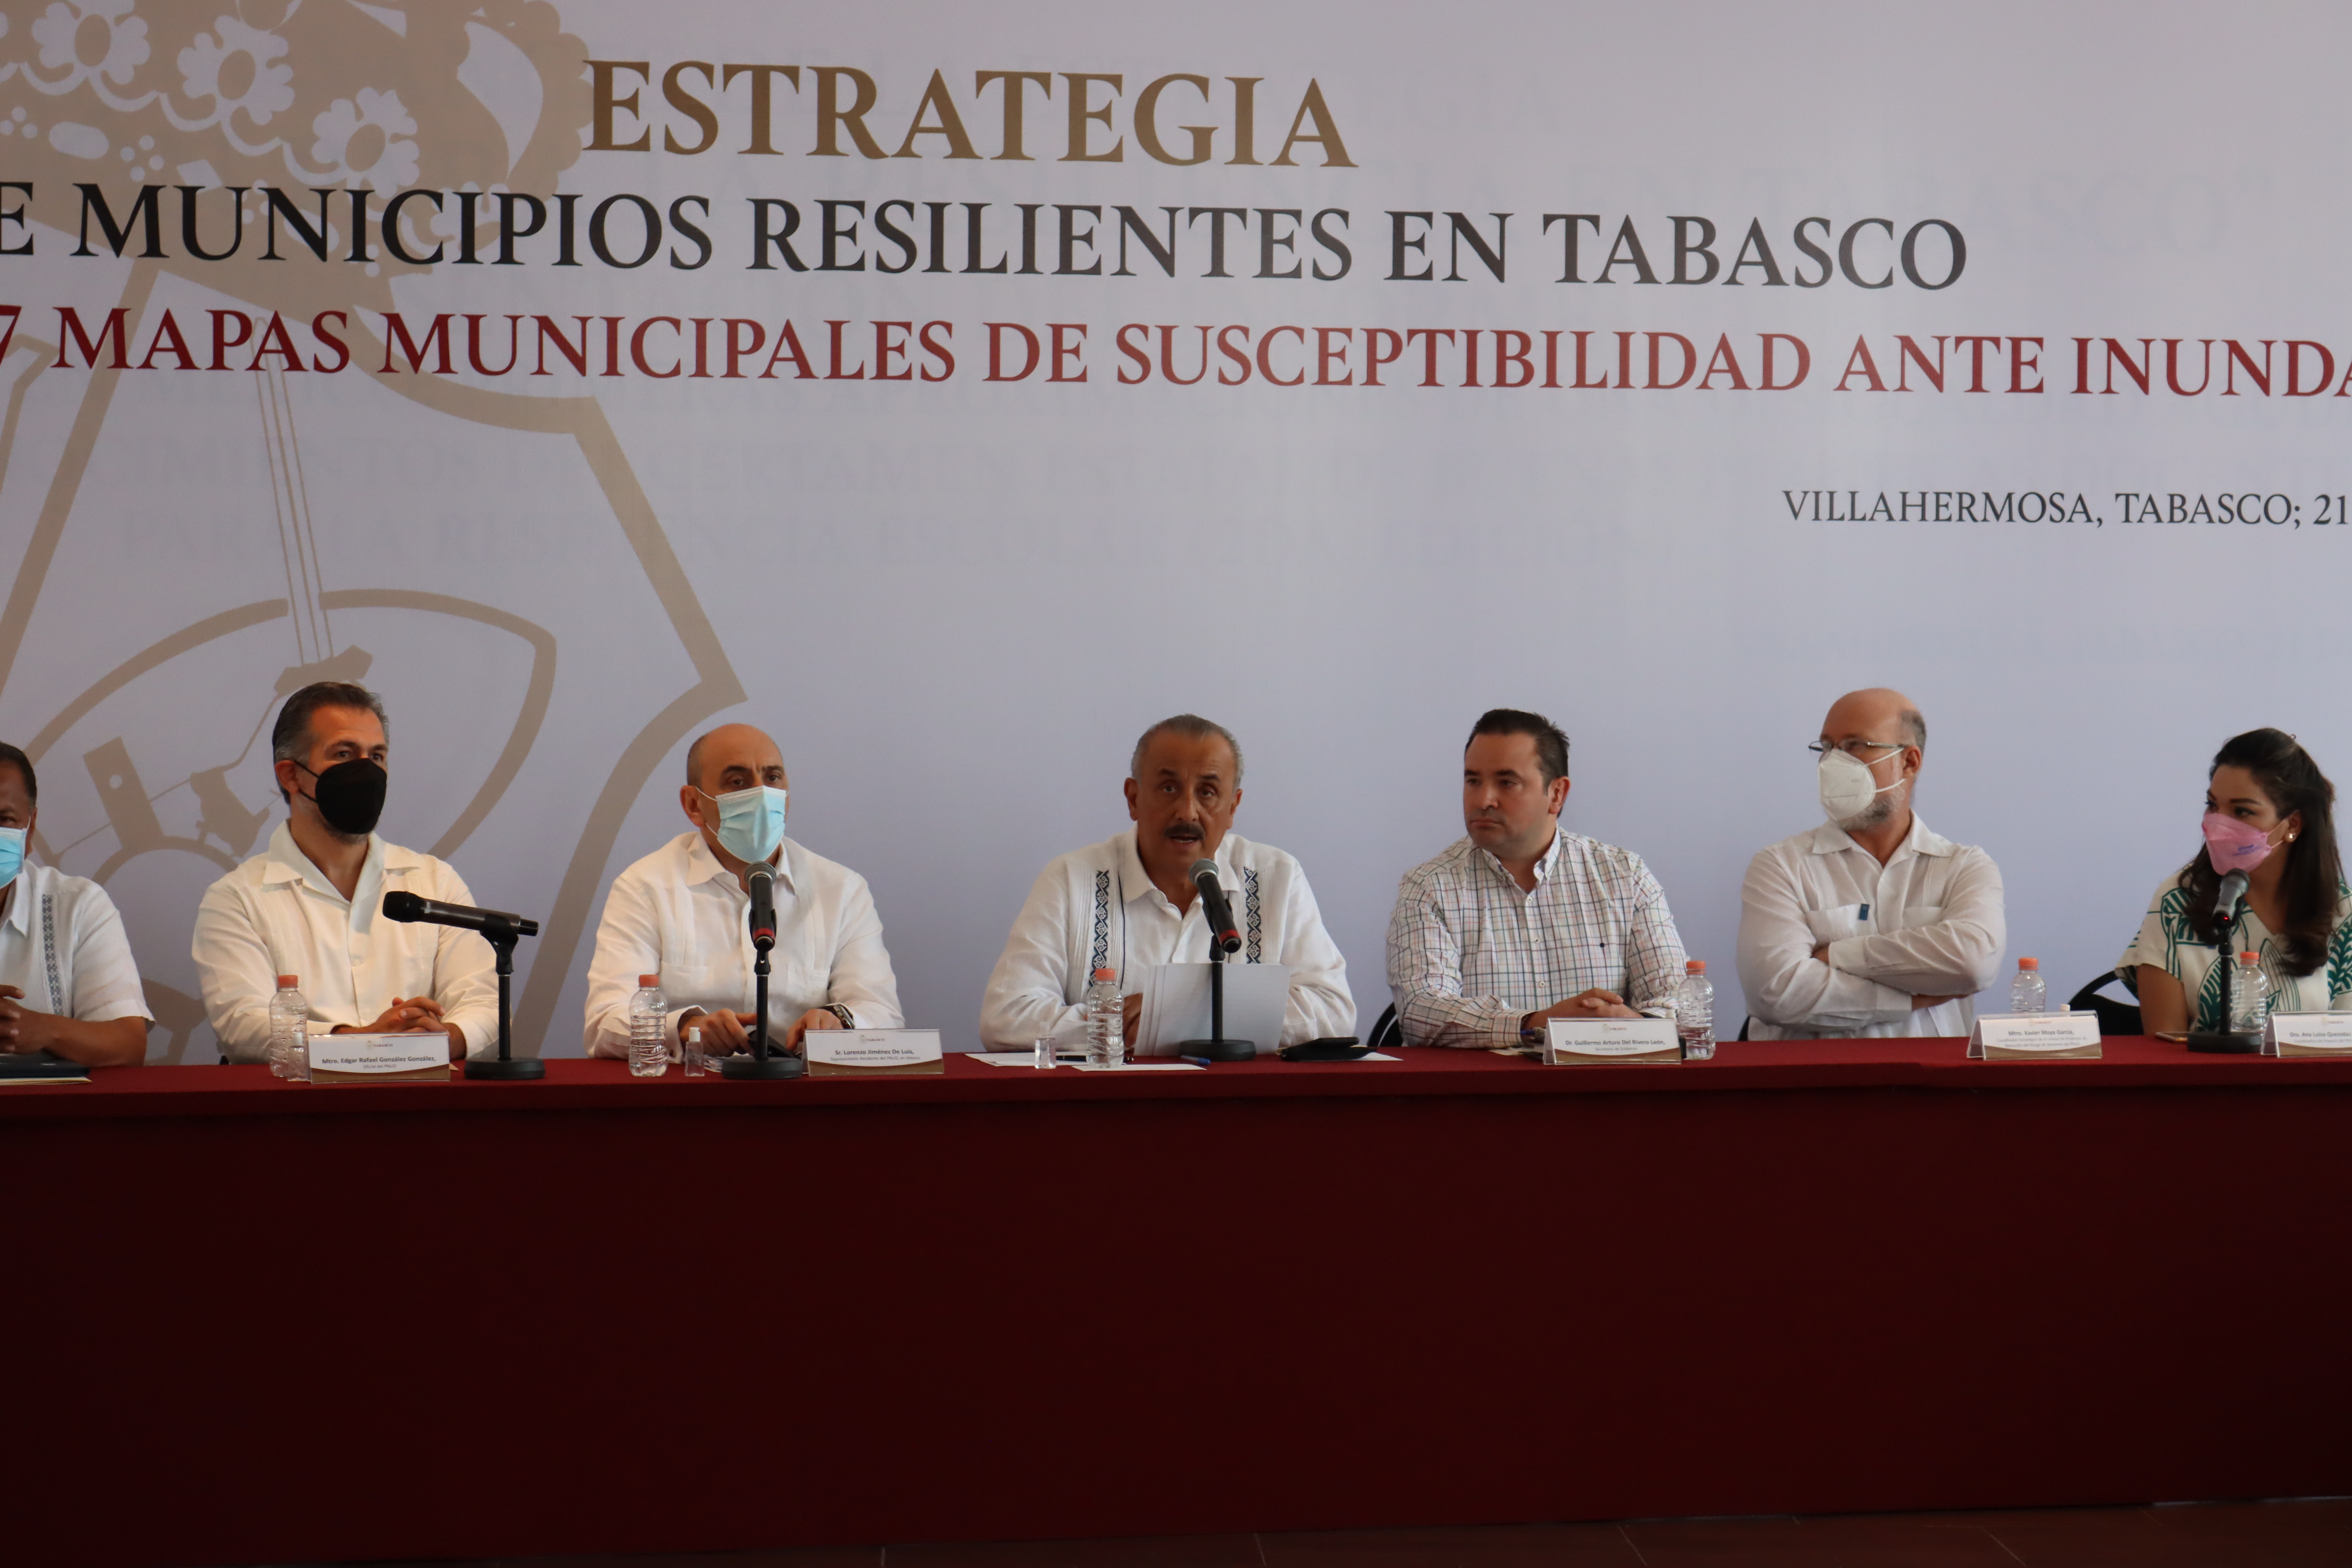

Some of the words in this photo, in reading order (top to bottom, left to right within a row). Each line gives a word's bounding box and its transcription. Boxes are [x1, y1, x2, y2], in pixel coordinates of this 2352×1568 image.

[582, 60, 1357, 168] ESTRATEGIA
[70, 183, 712, 270] MUNICIPIOS
[746, 198, 1351, 280] RESILIENTES
[1384, 211, 1514, 283] EN
[1543, 214, 1967, 290] TABASCO
[50, 307, 350, 373] MAPAS
[378, 313, 955, 381] MUNICIPALES
[983, 323, 1088, 383] DE
[1117, 324, 1810, 392] SUSCEPTIBILIDAD
[1834, 335, 2044, 395] ANTE
[2071, 337, 2352, 397] INUND
[1782, 490, 2104, 528] VILLAHERMOSA,
[2114, 493, 2300, 529] TABASCO;
[2313, 494, 2349, 525] 21
